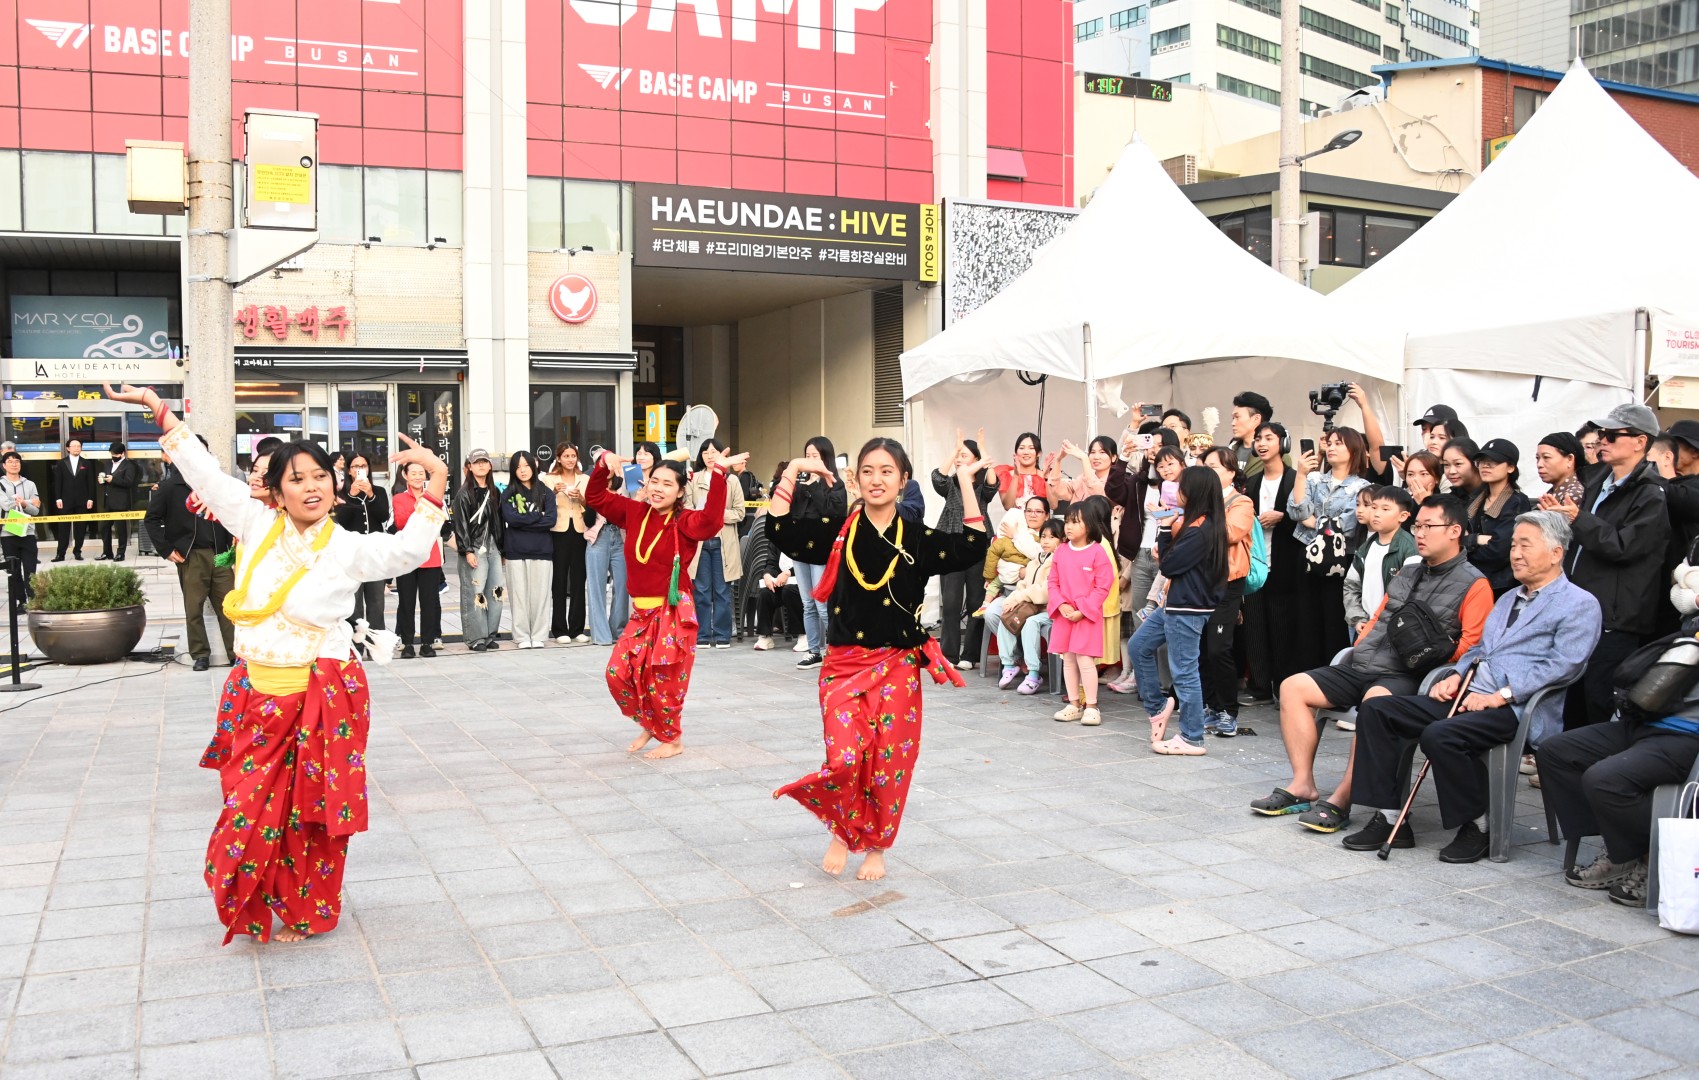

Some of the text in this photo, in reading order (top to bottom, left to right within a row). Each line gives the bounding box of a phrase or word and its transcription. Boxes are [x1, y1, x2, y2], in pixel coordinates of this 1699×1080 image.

[104, 25, 173, 57] BASE
[179, 31, 254, 62] CP
[285, 46, 399, 67] BUSAN
[639, 69, 693, 98] BASE
[698, 76, 757, 104] CAMP
[782, 90, 872, 112] BUSAN
[652, 196, 823, 232] HAEUNDAE
[840, 209, 907, 237] HIVE
[924, 208, 934, 233] HOF
[652, 238, 907, 267] #단체룸 #프리미엄기본안주 #각룸화장실완비
[924, 244, 934, 277] SOJU
[14, 313, 58, 325] MAR
[235, 304, 351, 340] 생활맥주
